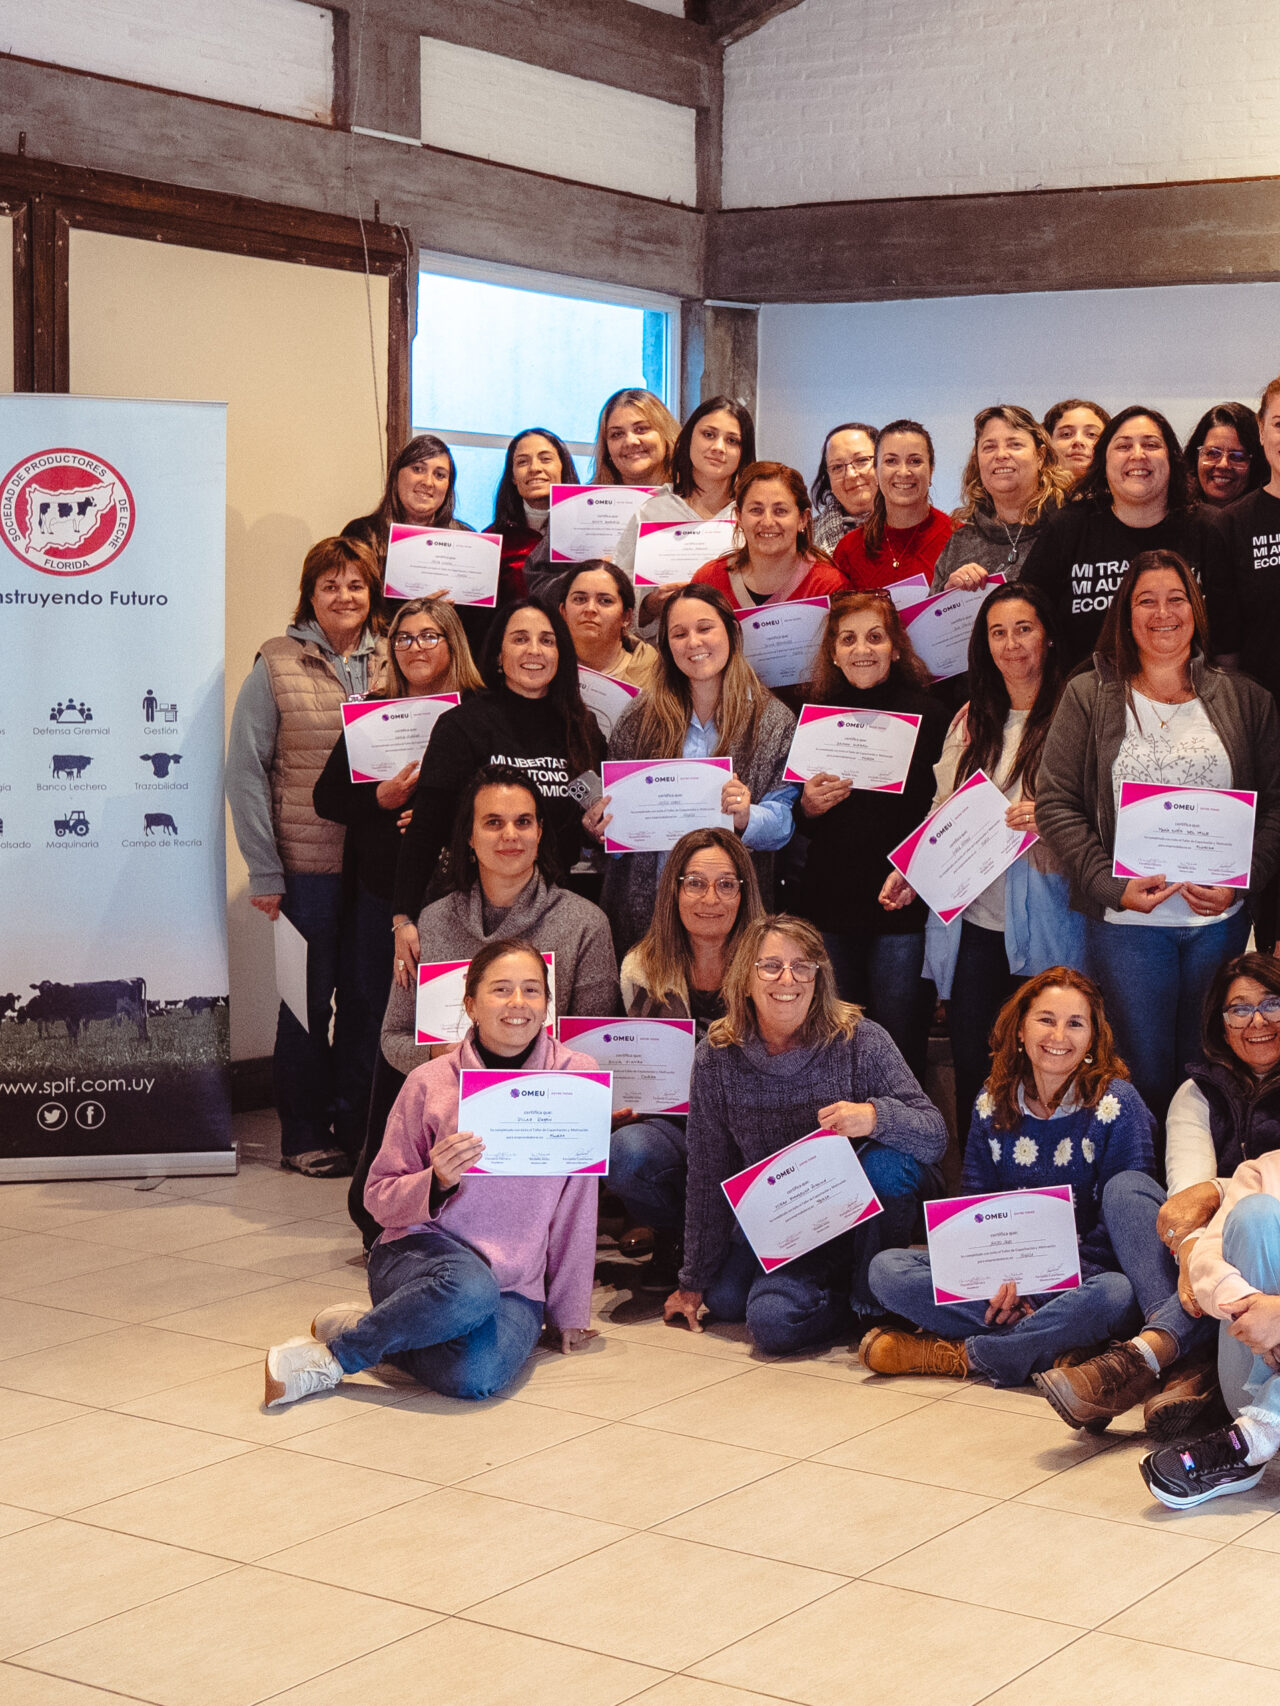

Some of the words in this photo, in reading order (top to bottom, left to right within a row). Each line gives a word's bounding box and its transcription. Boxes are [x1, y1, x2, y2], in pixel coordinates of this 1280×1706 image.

[24, 454, 107, 477] PRODUCTORES
[11, 473, 26, 487] DE
[118, 498, 129, 513] DE
[3, 488, 21, 543] SOCIEDAD
[108, 515, 128, 550] LECHE
[1252, 535, 1268, 546] MI
[1253, 546, 1268, 558] MI
[44, 558, 90, 570] FLORIDA
[1071, 563, 1093, 578] MI
[1071, 580, 1092, 595] MI
[1095, 576, 1124, 593] AU
[110, 591, 168, 606] Futuro
[33, 727, 71, 736] Defensa
[73, 727, 111, 736] Gremial
[143, 726, 178, 736] Gestión
[490, 755, 506, 765] MI
[36, 782, 67, 792] Banco
[69, 782, 107, 791] Lechero
[134, 782, 189, 791] Trazabilidad
[1173, 803, 1195, 811] OMEU
[46, 840, 99, 850] Maquinaria
[121, 839, 156, 849] Campo
[159, 839, 171, 848] de
[173, 838, 202, 847] Recría
[0, 1076, 155, 1097] ww.splf.com.uy
[775, 1166, 796, 1180] OMEU
[984, 1212, 1008, 1220] OMEU
